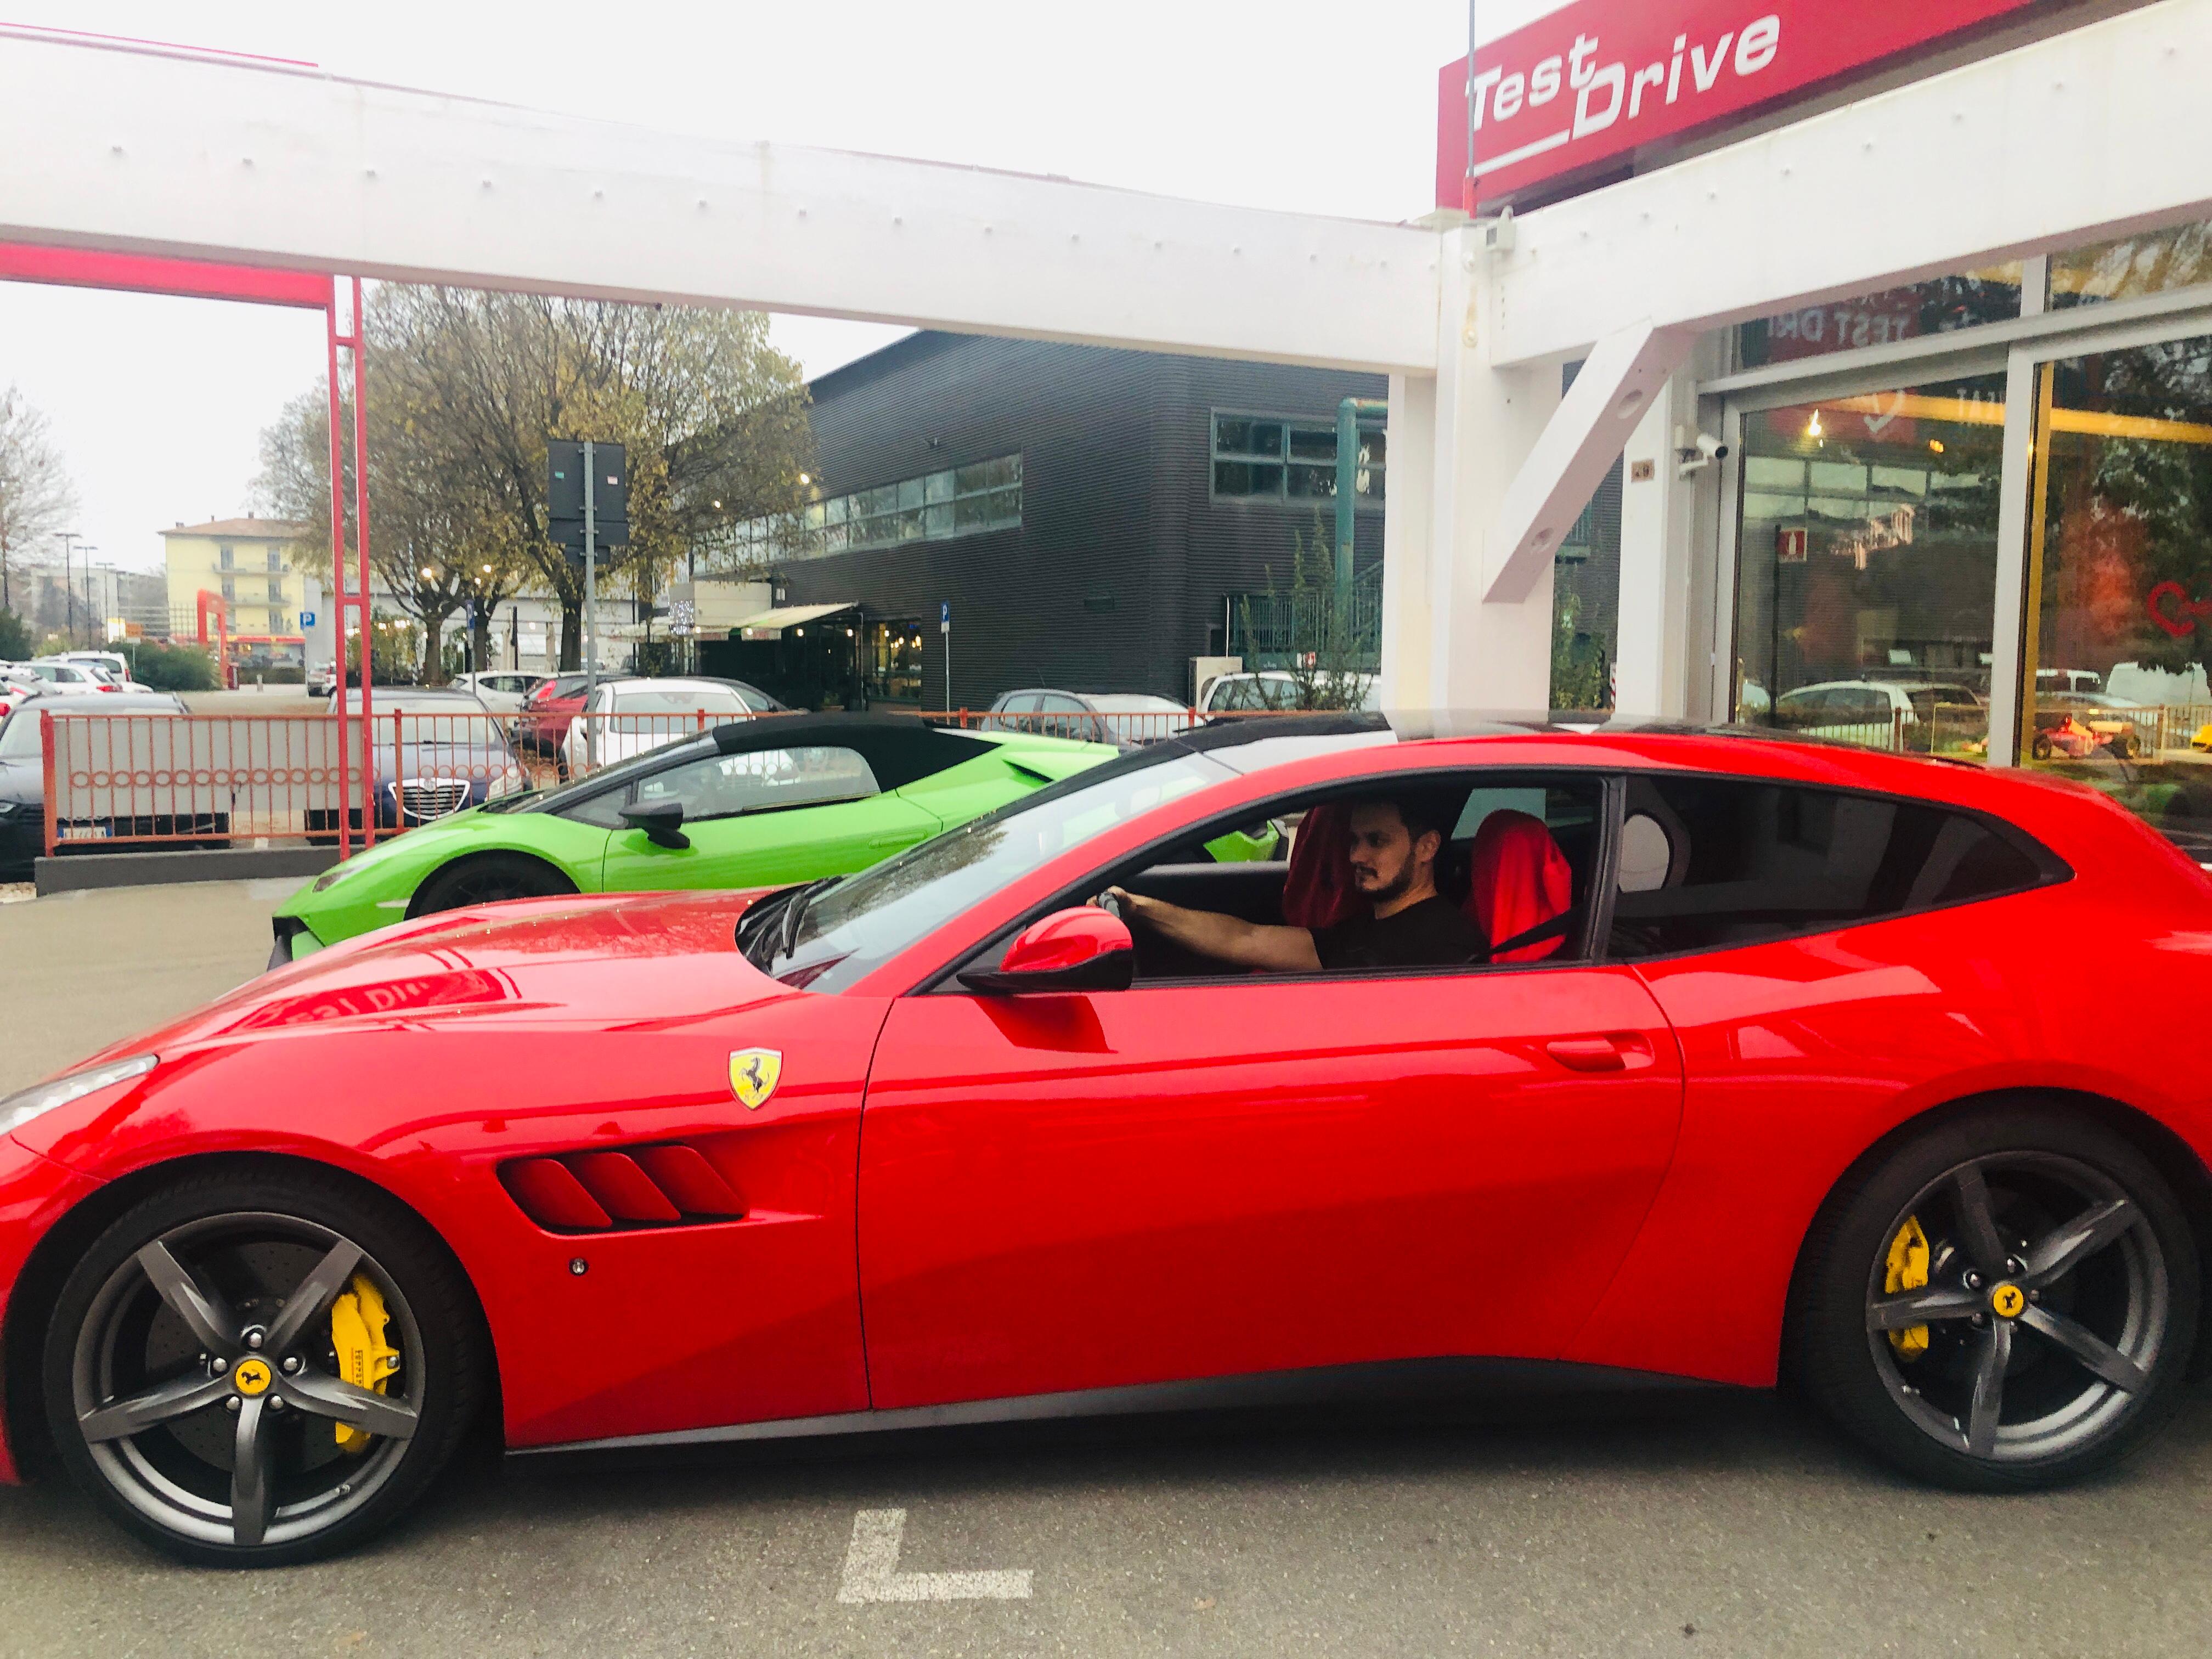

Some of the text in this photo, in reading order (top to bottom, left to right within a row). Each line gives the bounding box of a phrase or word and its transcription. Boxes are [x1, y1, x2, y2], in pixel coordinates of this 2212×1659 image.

[1465, 14, 1781, 140] Test Drive
[303, 613, 312, 627] P
[943, 604, 947, 620] P
